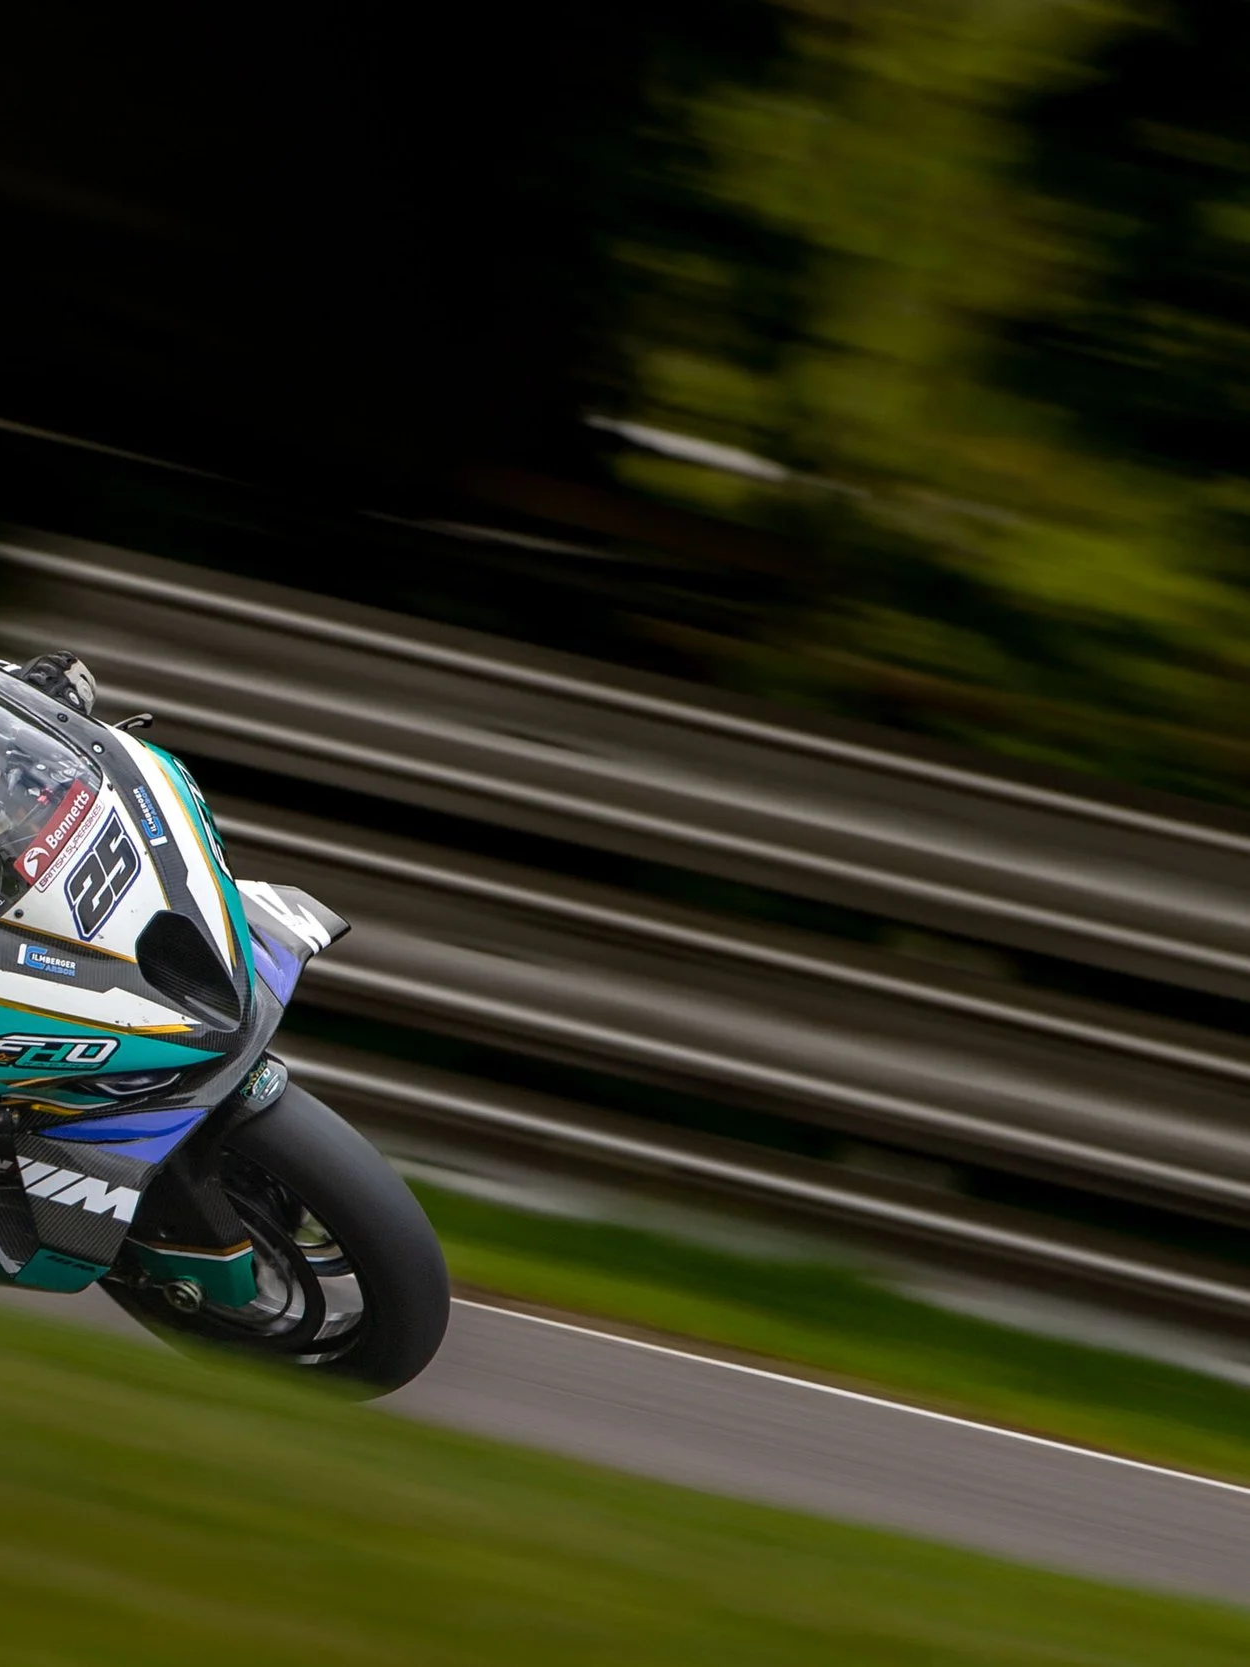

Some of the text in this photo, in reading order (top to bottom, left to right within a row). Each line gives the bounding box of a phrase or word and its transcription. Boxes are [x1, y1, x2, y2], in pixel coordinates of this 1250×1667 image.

[39, 803, 102, 888] BRITISH SUPERBIKES
[45, 790, 90, 850] Bennetts
[68, 813, 139, 938] 25
[31, 952, 77, 969] ILMBERGER
